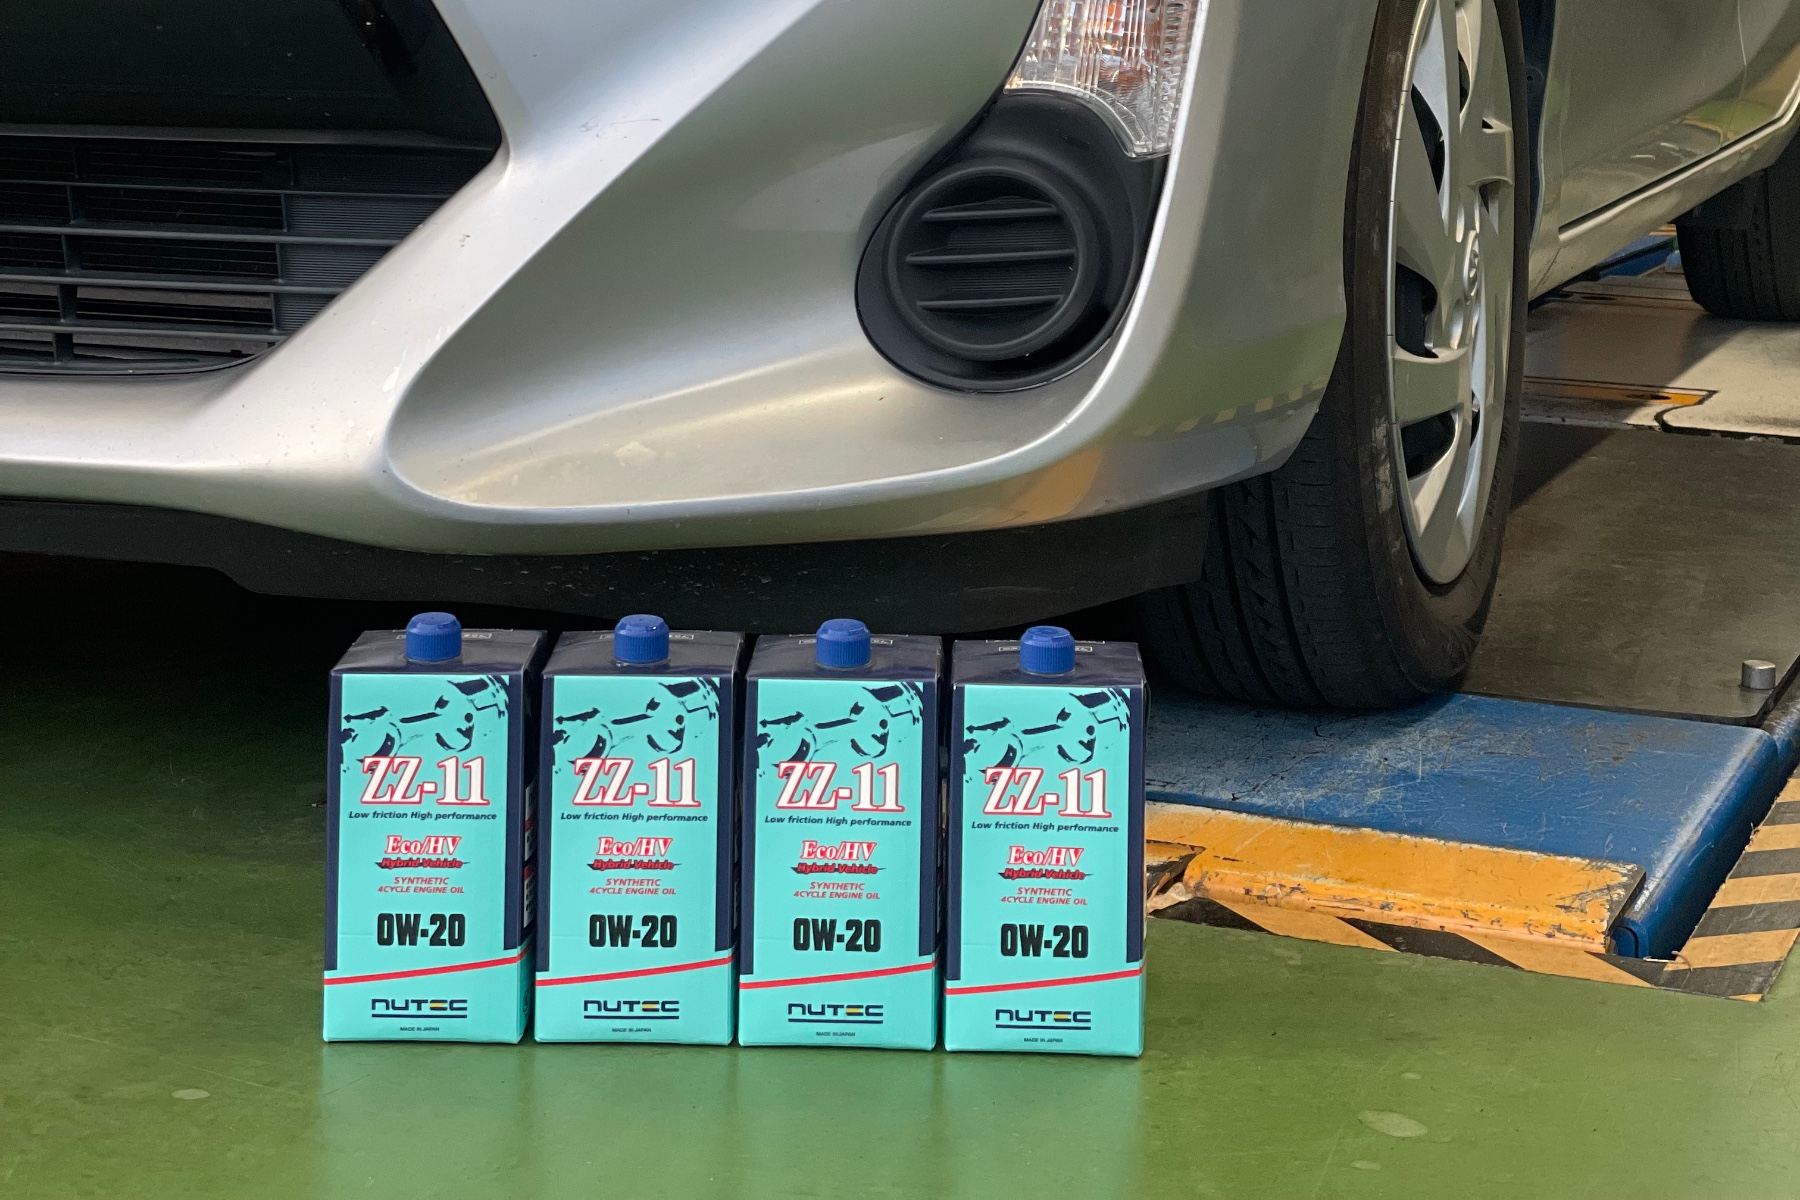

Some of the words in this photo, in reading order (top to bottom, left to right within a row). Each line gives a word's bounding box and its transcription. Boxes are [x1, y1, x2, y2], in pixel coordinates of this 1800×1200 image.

[360, 755, 490, 806] ZZ-11
[572, 756, 702, 808] ZZ-11
[776, 761, 905, 812] ZZ-11
[983, 767, 1112, 819] ZZ-11
[349, 811, 369, 819] Low
[372, 811, 408, 819] friction
[411, 811, 433, 820] High
[435, 812, 497, 820] performance
[561, 812, 581, 821] Low
[584, 812, 620, 821] friction
[623, 812, 645, 822] High
[647, 813, 709, 822] performance
[788, 816, 823, 824] friction
[826, 817, 848, 826] High
[850, 818, 912, 827] performance
[971, 821, 992, 829] Low
[995, 821, 1030, 830] friction
[1033, 822, 1055, 832] High
[1057, 823, 1119, 833] performance
[384, 835, 462, 855] Eco/HV
[596, 836, 674, 857] Eco/HV
[801, 840, 877, 861] Eco/HV
[381, 857, 421, 869] Hybrid
[421, 858, 463, 869] Vehicle
[1007, 846, 1084, 867] Eco/HV
[593, 858, 633, 871] Hybrid
[633, 859, 675, 871] Vehicle
[796, 863, 836, 874] Hybrid
[837, 863, 878, 874] Vehicle
[1004, 868, 1043, 880] Hybrid
[1044, 868, 1086, 880] Vehicle
[394, 877, 450, 885] SYNTHETIC
[606, 878, 662, 887] SYNTHETIC
[810, 882, 865, 890] SYNTHETIC
[589, 887, 623, 895] 4CYCLE
[625, 887, 659, 895] ENGINE
[662, 887, 677, 895] OIL
[829, 891, 863, 899] ENGINE
[1017, 887, 1072, 896] SYNTHETIC
[1001, 896, 1034, 904] 4CYCLE
[1036, 897, 1070, 905] ENGINE
[377, 913, 466, 946] 0W-20
[589, 914, 678, 948] 0W-20
[793, 918, 881, 952] 0W-20
[1001, 923, 1089, 958] 0W-20
[371, 999, 468, 1011] NUTEC
[583, 1000, 680, 1013] NUTEC
[788, 1003, 884, 1017] NUTEC
[995, 1009, 1092, 1022] NUTEC
